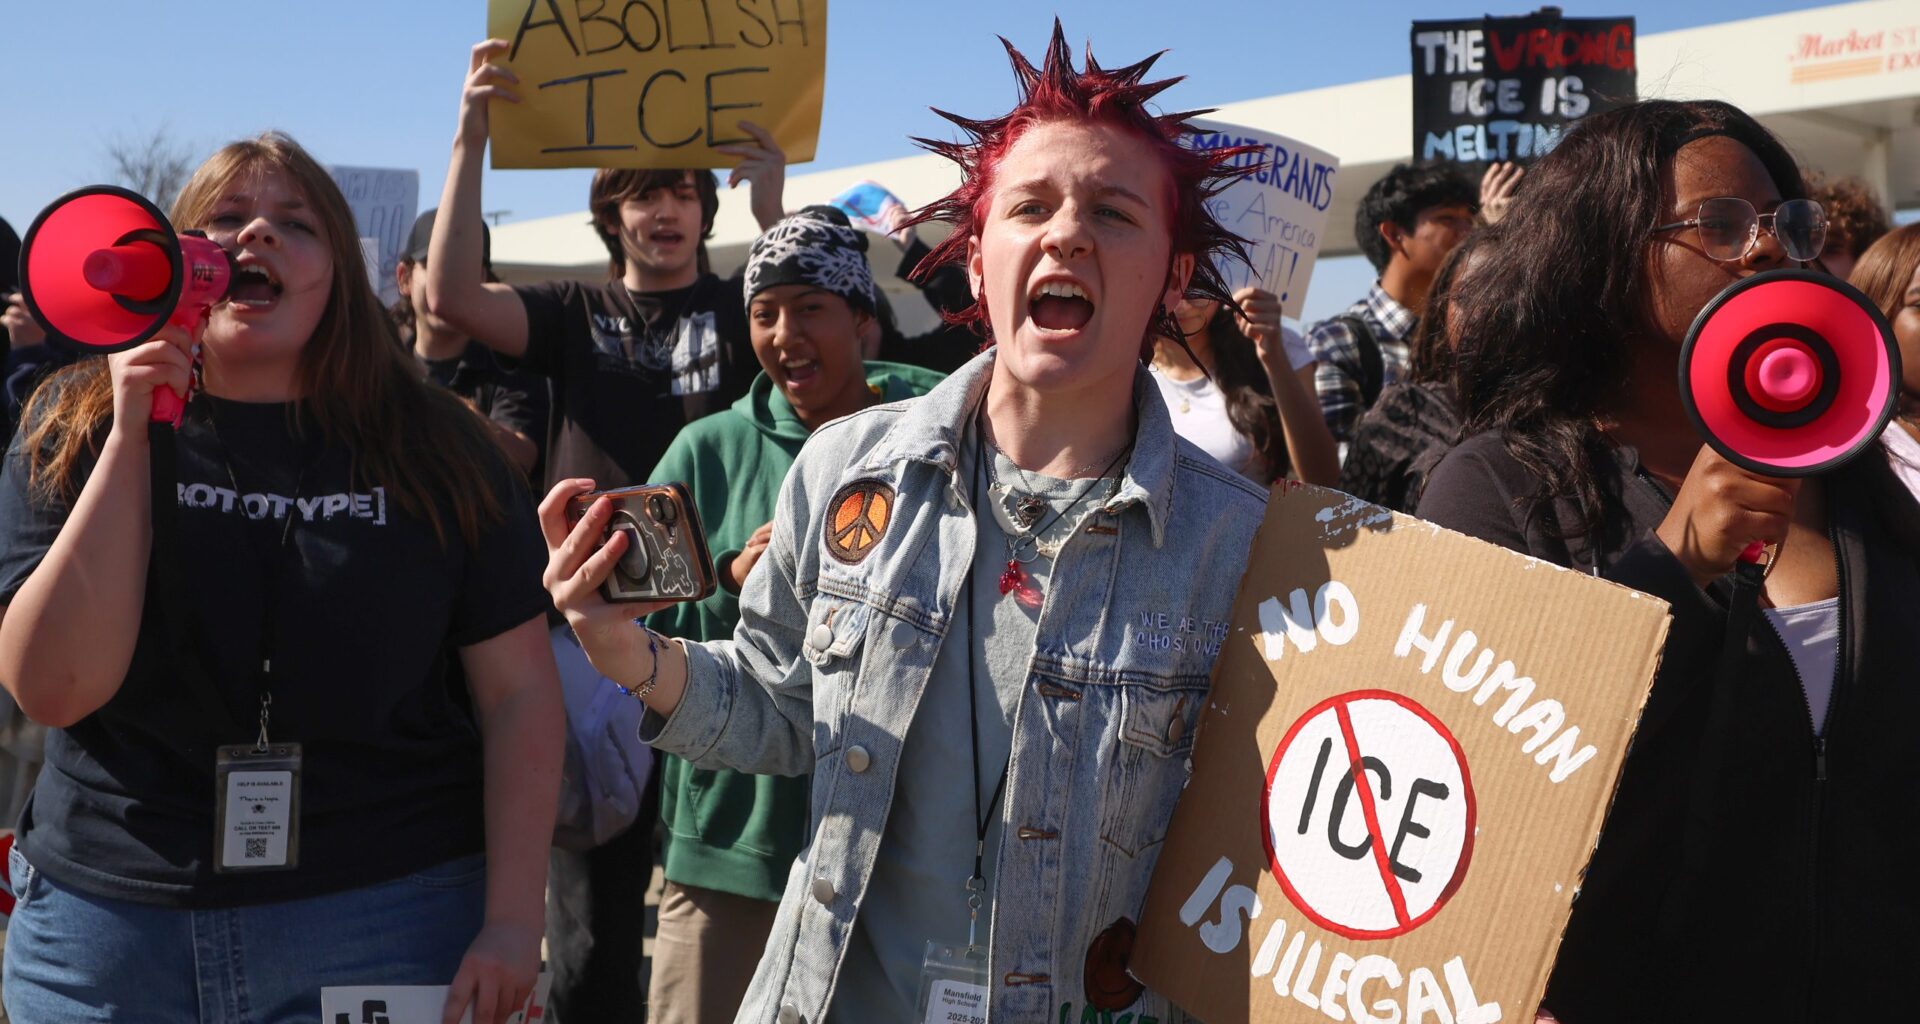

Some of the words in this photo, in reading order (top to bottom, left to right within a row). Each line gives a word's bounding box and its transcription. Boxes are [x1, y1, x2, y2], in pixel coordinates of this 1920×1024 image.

[509, 0, 808, 61] ABOLISH
[1416, 30, 1485, 75] THE
[1489, 24, 1636, 71] WRONG
[1788, 29, 1883, 60] Market
[1887, 50, 1920, 73] EX
[538, 67, 769, 153] ICE
[1450, 78, 1525, 117] ICE
[1540, 75, 1591, 119] IS
[1423, 120, 1568, 162] MELTIN
[1180, 133, 1337, 212] MMIGRANTS
[1236, 192, 1316, 249] America
[1140, 611, 1170, 629] WE
[1258, 581, 1360, 660] NO
[1394, 603, 1598, 784] HUMAN
[1297, 737, 1450, 884] ICE
[1179, 856, 1262, 954] IS
[1250, 918, 1502, 1024] ILLEGAL
[942, 996, 956, 1005] High
[957, 999, 978, 1008] School
[944, 987, 982, 1002] Mansfield
[947, 1011, 986, 1024] 2025-202
